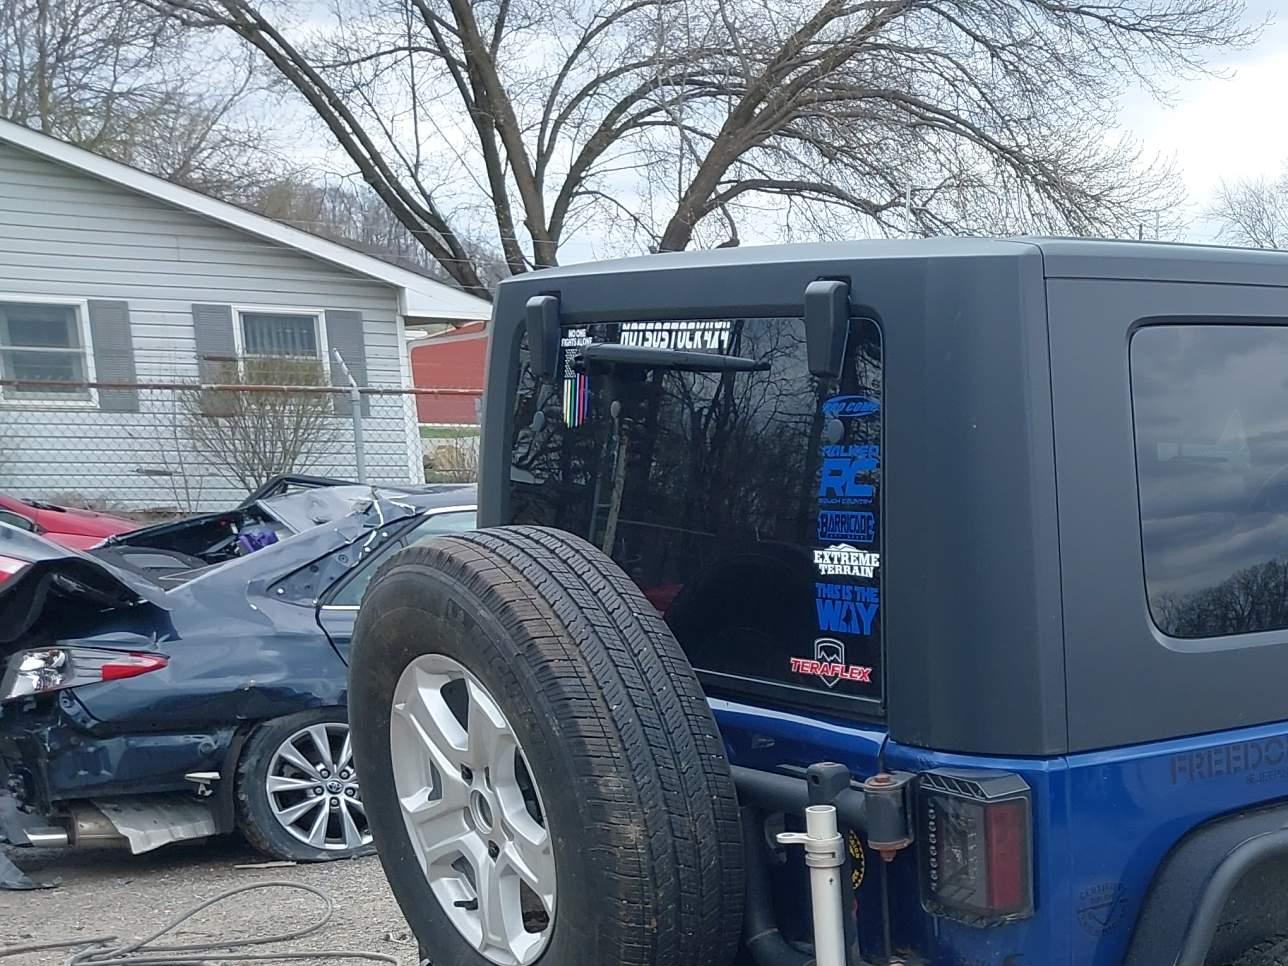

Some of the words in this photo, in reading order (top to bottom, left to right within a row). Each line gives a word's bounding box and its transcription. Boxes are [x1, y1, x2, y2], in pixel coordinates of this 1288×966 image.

[818, 458, 880, 497] RC
[819, 513, 874, 540] BARRICADE
[813, 550, 880, 567] EXTREME
[819, 565, 875, 578] TERRAIN
[815, 582, 841, 600] THIS
[842, 584, 853, 601] IS
[854, 586, 879, 603] THE
[815, 598, 879, 636] WAY
[790, 657, 871, 682] TERAFLEX
